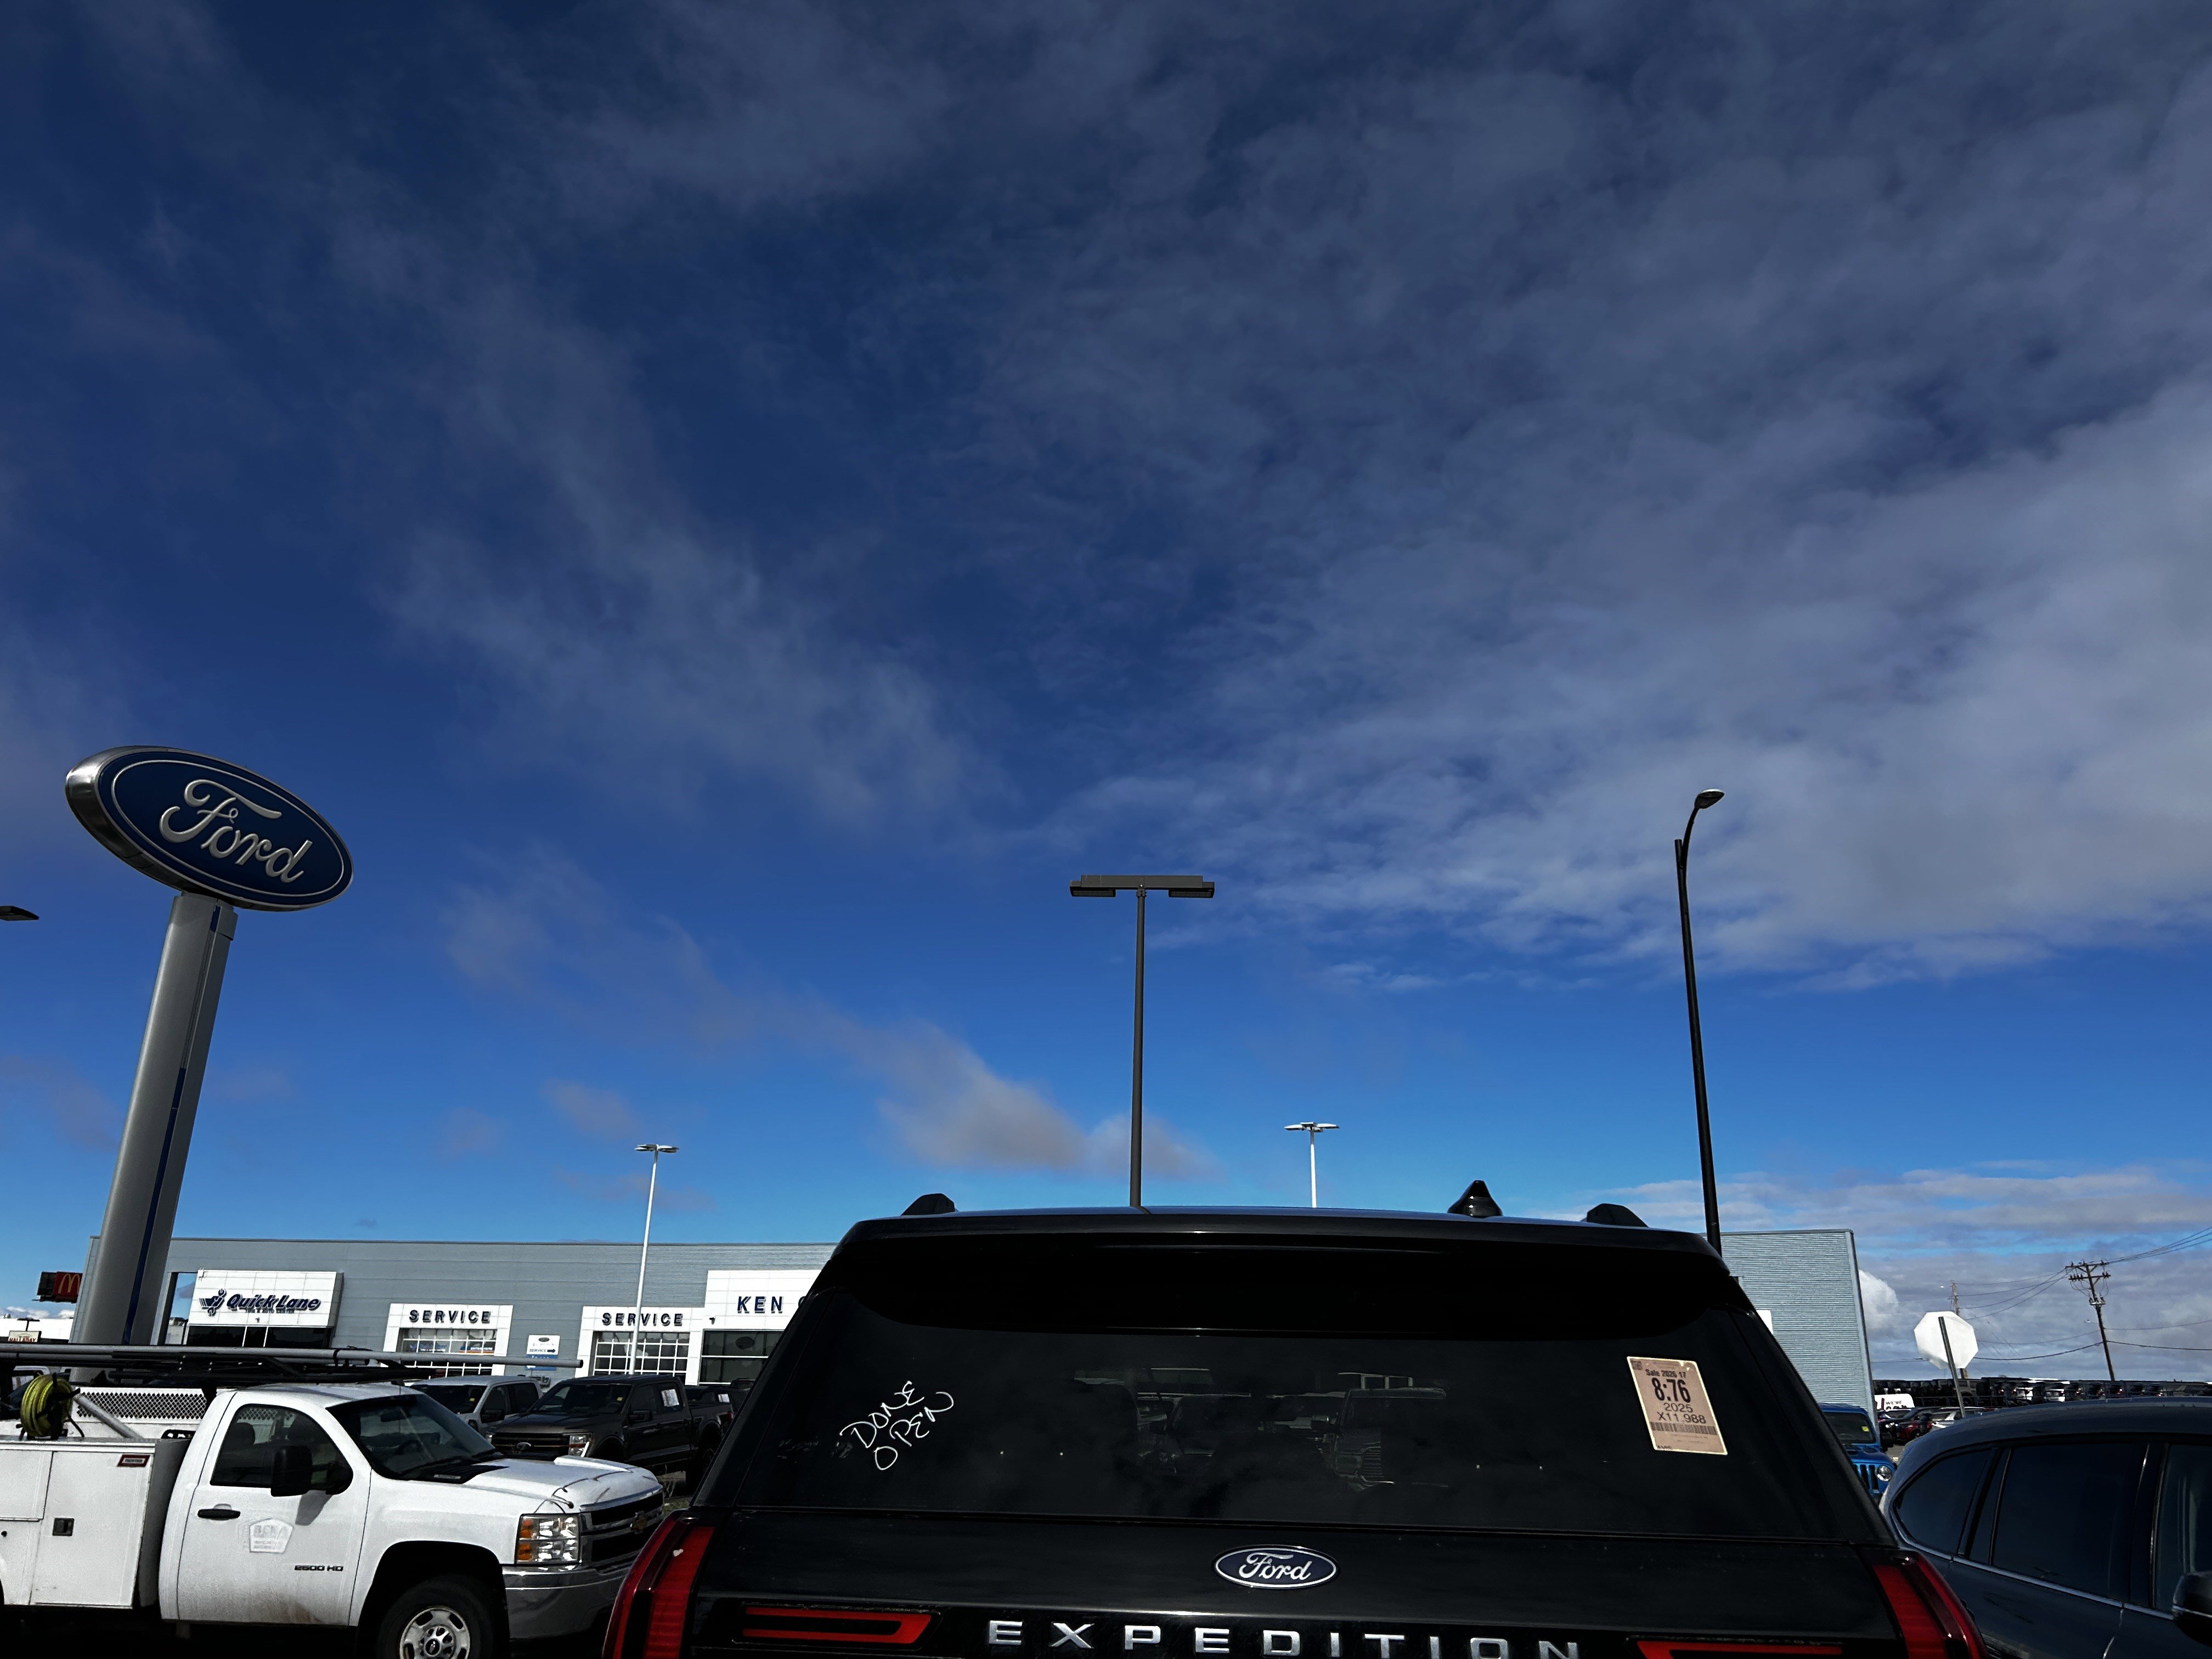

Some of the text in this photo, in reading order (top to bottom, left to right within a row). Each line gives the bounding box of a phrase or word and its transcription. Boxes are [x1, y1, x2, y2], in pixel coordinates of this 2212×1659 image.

[160, 779, 313, 883] Ford
[226, 1294, 321, 1311] Quick Lane
[737, 1296, 785, 1313] KEN
[409, 1310, 491, 1323] SERVICE
[602, 1313, 683, 1327] SERVICE
[1651, 1377, 1691, 1403] 8:76
[839, 1380, 925, 1448] DONE
[1663, 1402, 1693, 1413] 2025
[873, 1391, 954, 1470] OPEN
[1238, 1552, 1313, 1581] Ford
[989, 1620, 1578, 1659] EXPEDITION
